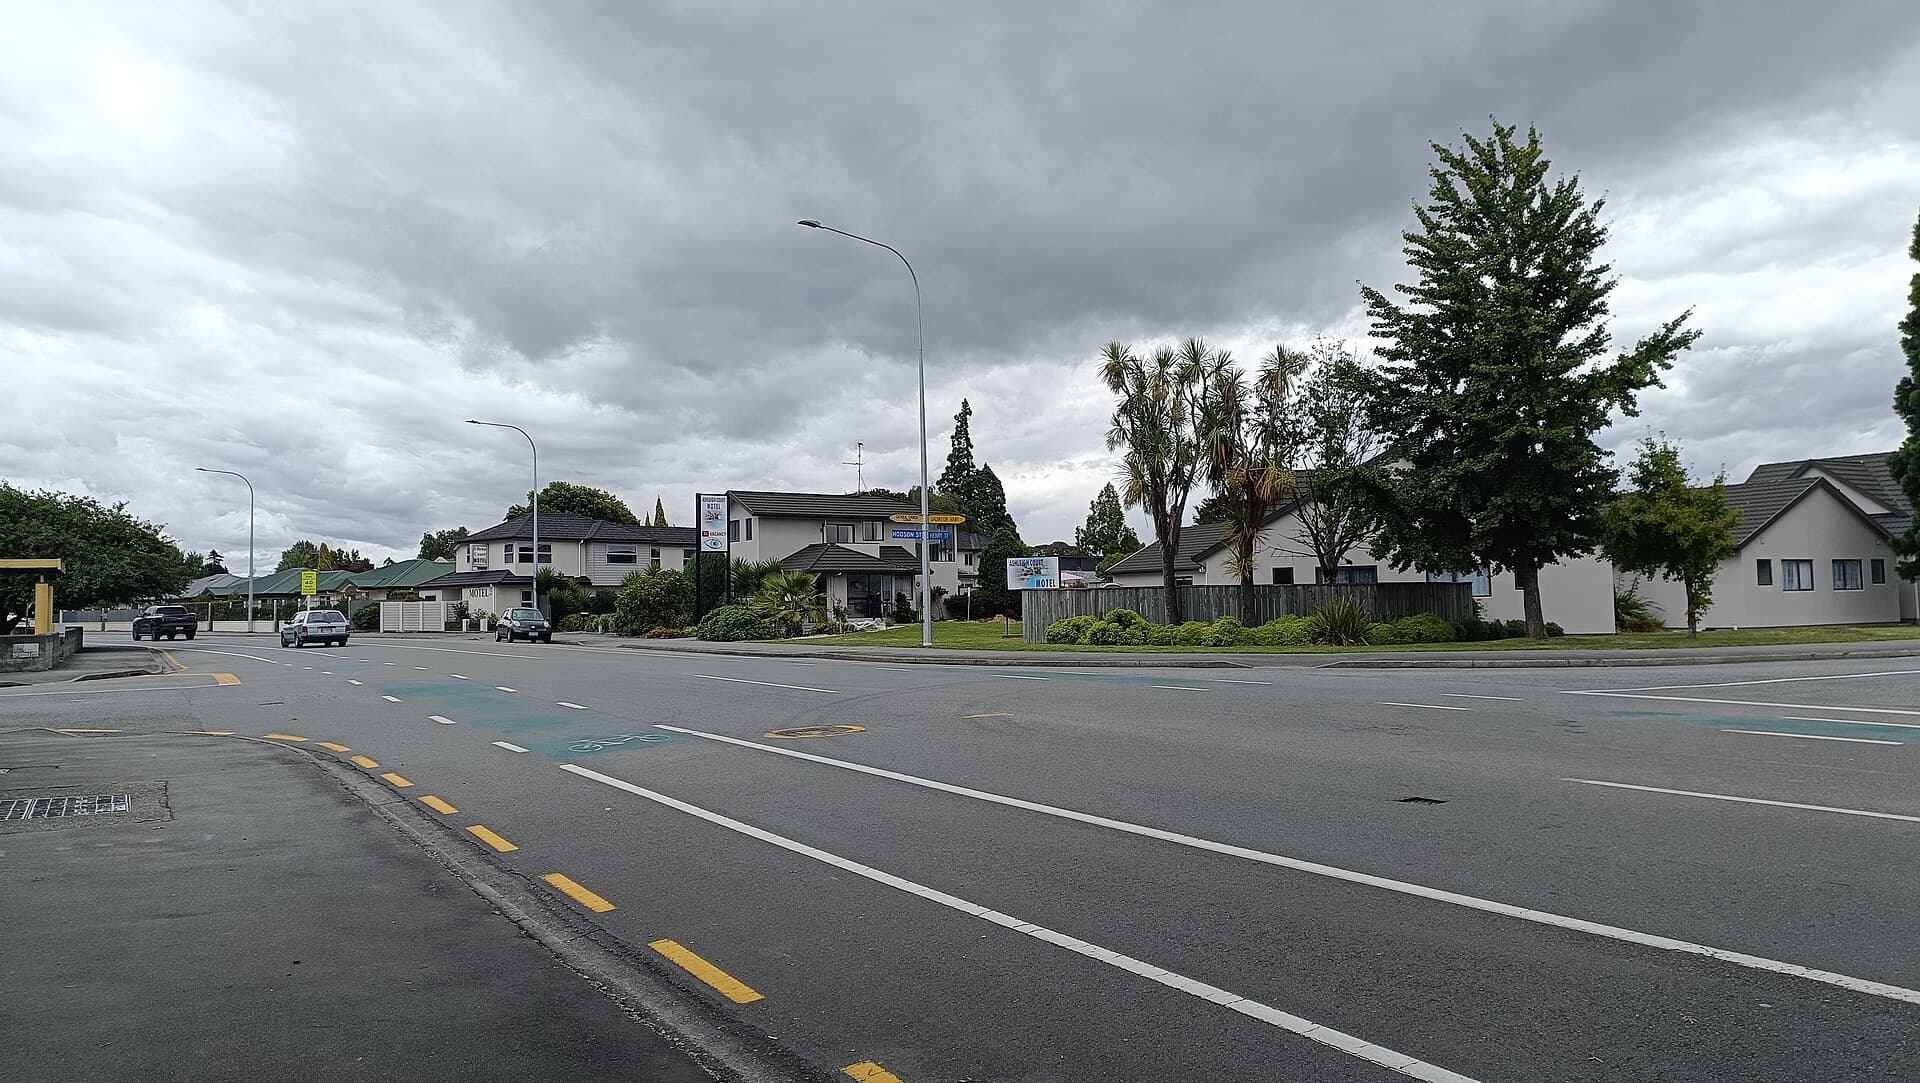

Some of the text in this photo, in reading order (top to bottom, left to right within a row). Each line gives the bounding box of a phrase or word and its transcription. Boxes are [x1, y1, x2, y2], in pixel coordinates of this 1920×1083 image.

[1029, 559, 1044, 567] COURT
[1035, 578, 1056, 588] MOTEL
[470, 588, 488, 598] MOTEL
